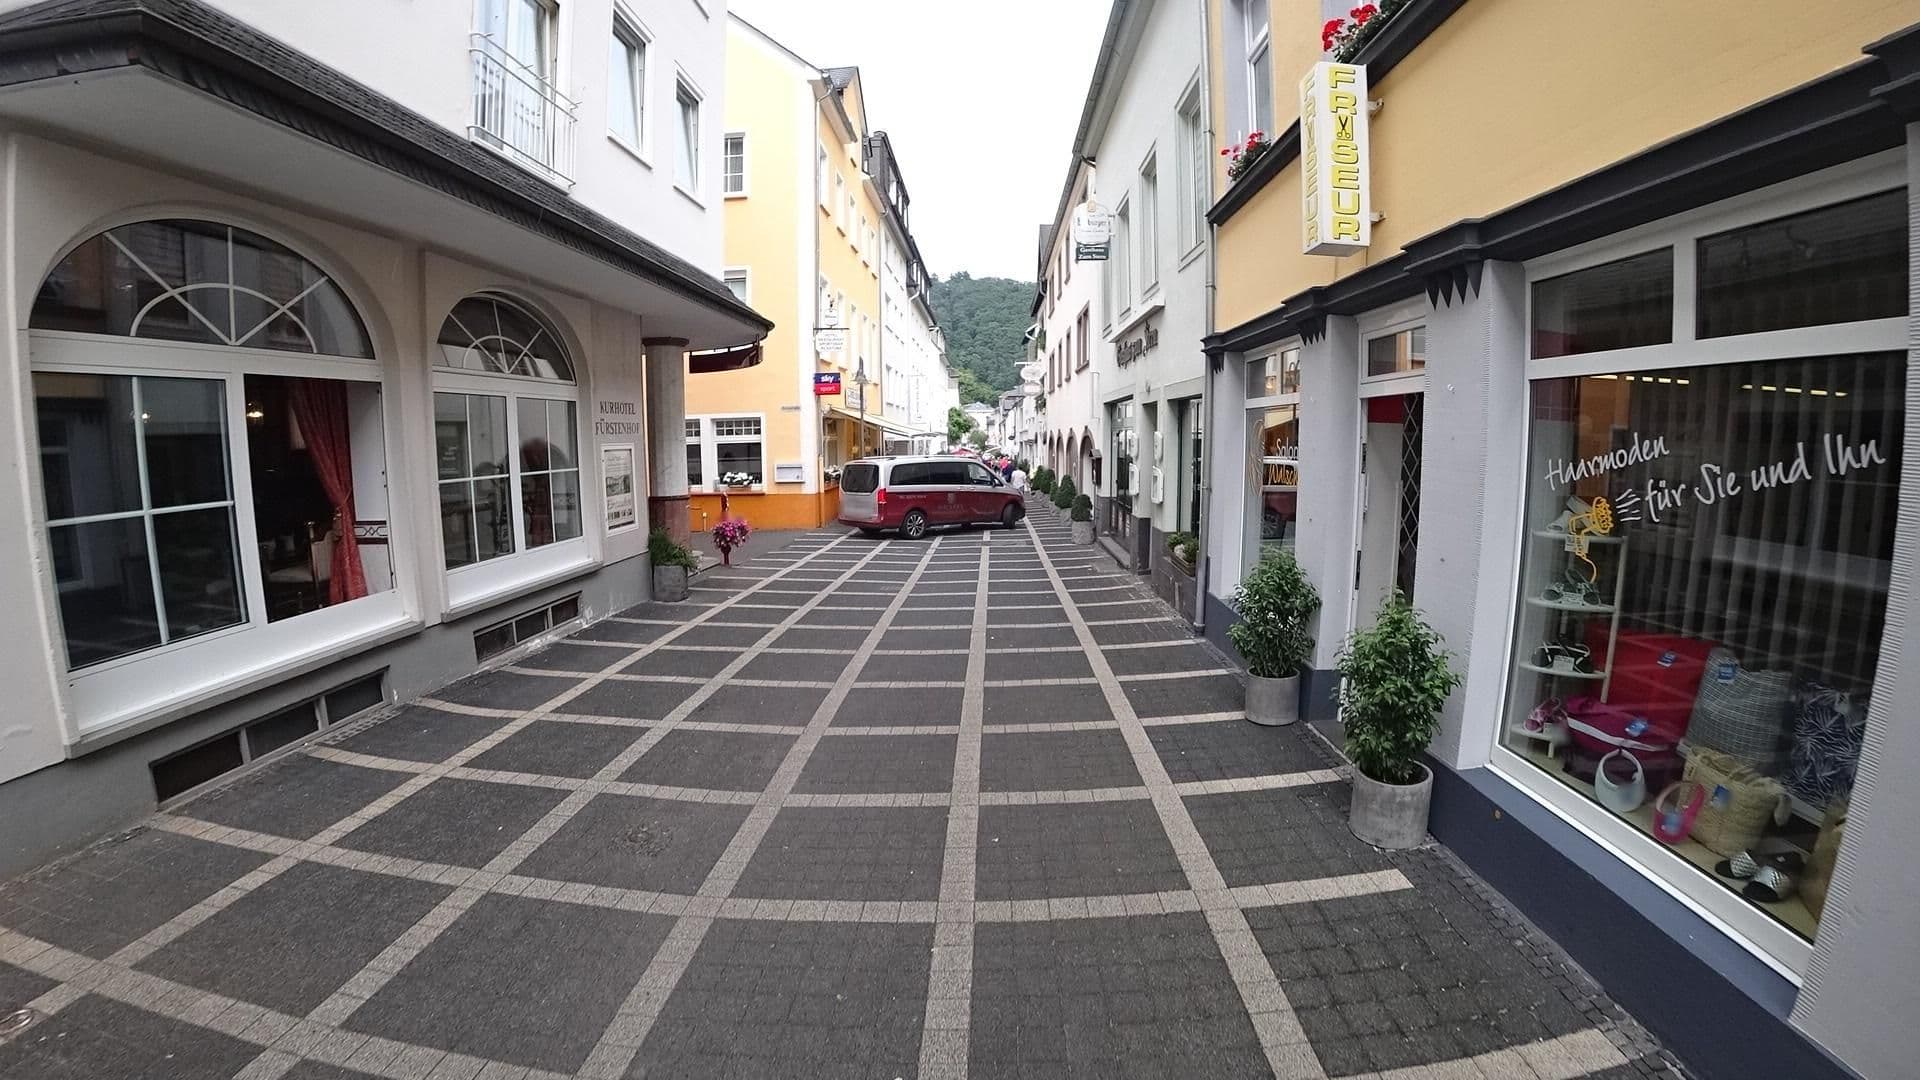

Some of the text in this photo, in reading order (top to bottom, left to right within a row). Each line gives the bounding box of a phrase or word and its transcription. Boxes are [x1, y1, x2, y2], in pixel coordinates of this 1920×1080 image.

[821, 374, 834, 384] sky
[820, 385, 836, 393] sport
[600, 401, 636, 415] KURHOTEL
[595, 418, 640, 436] FÜRSTENHOF
[1276, 437, 1299, 460] Salon
[1545, 432, 1670, 491] Haarmoden
[1645, 433, 1885, 523] für Sie und Ihn
